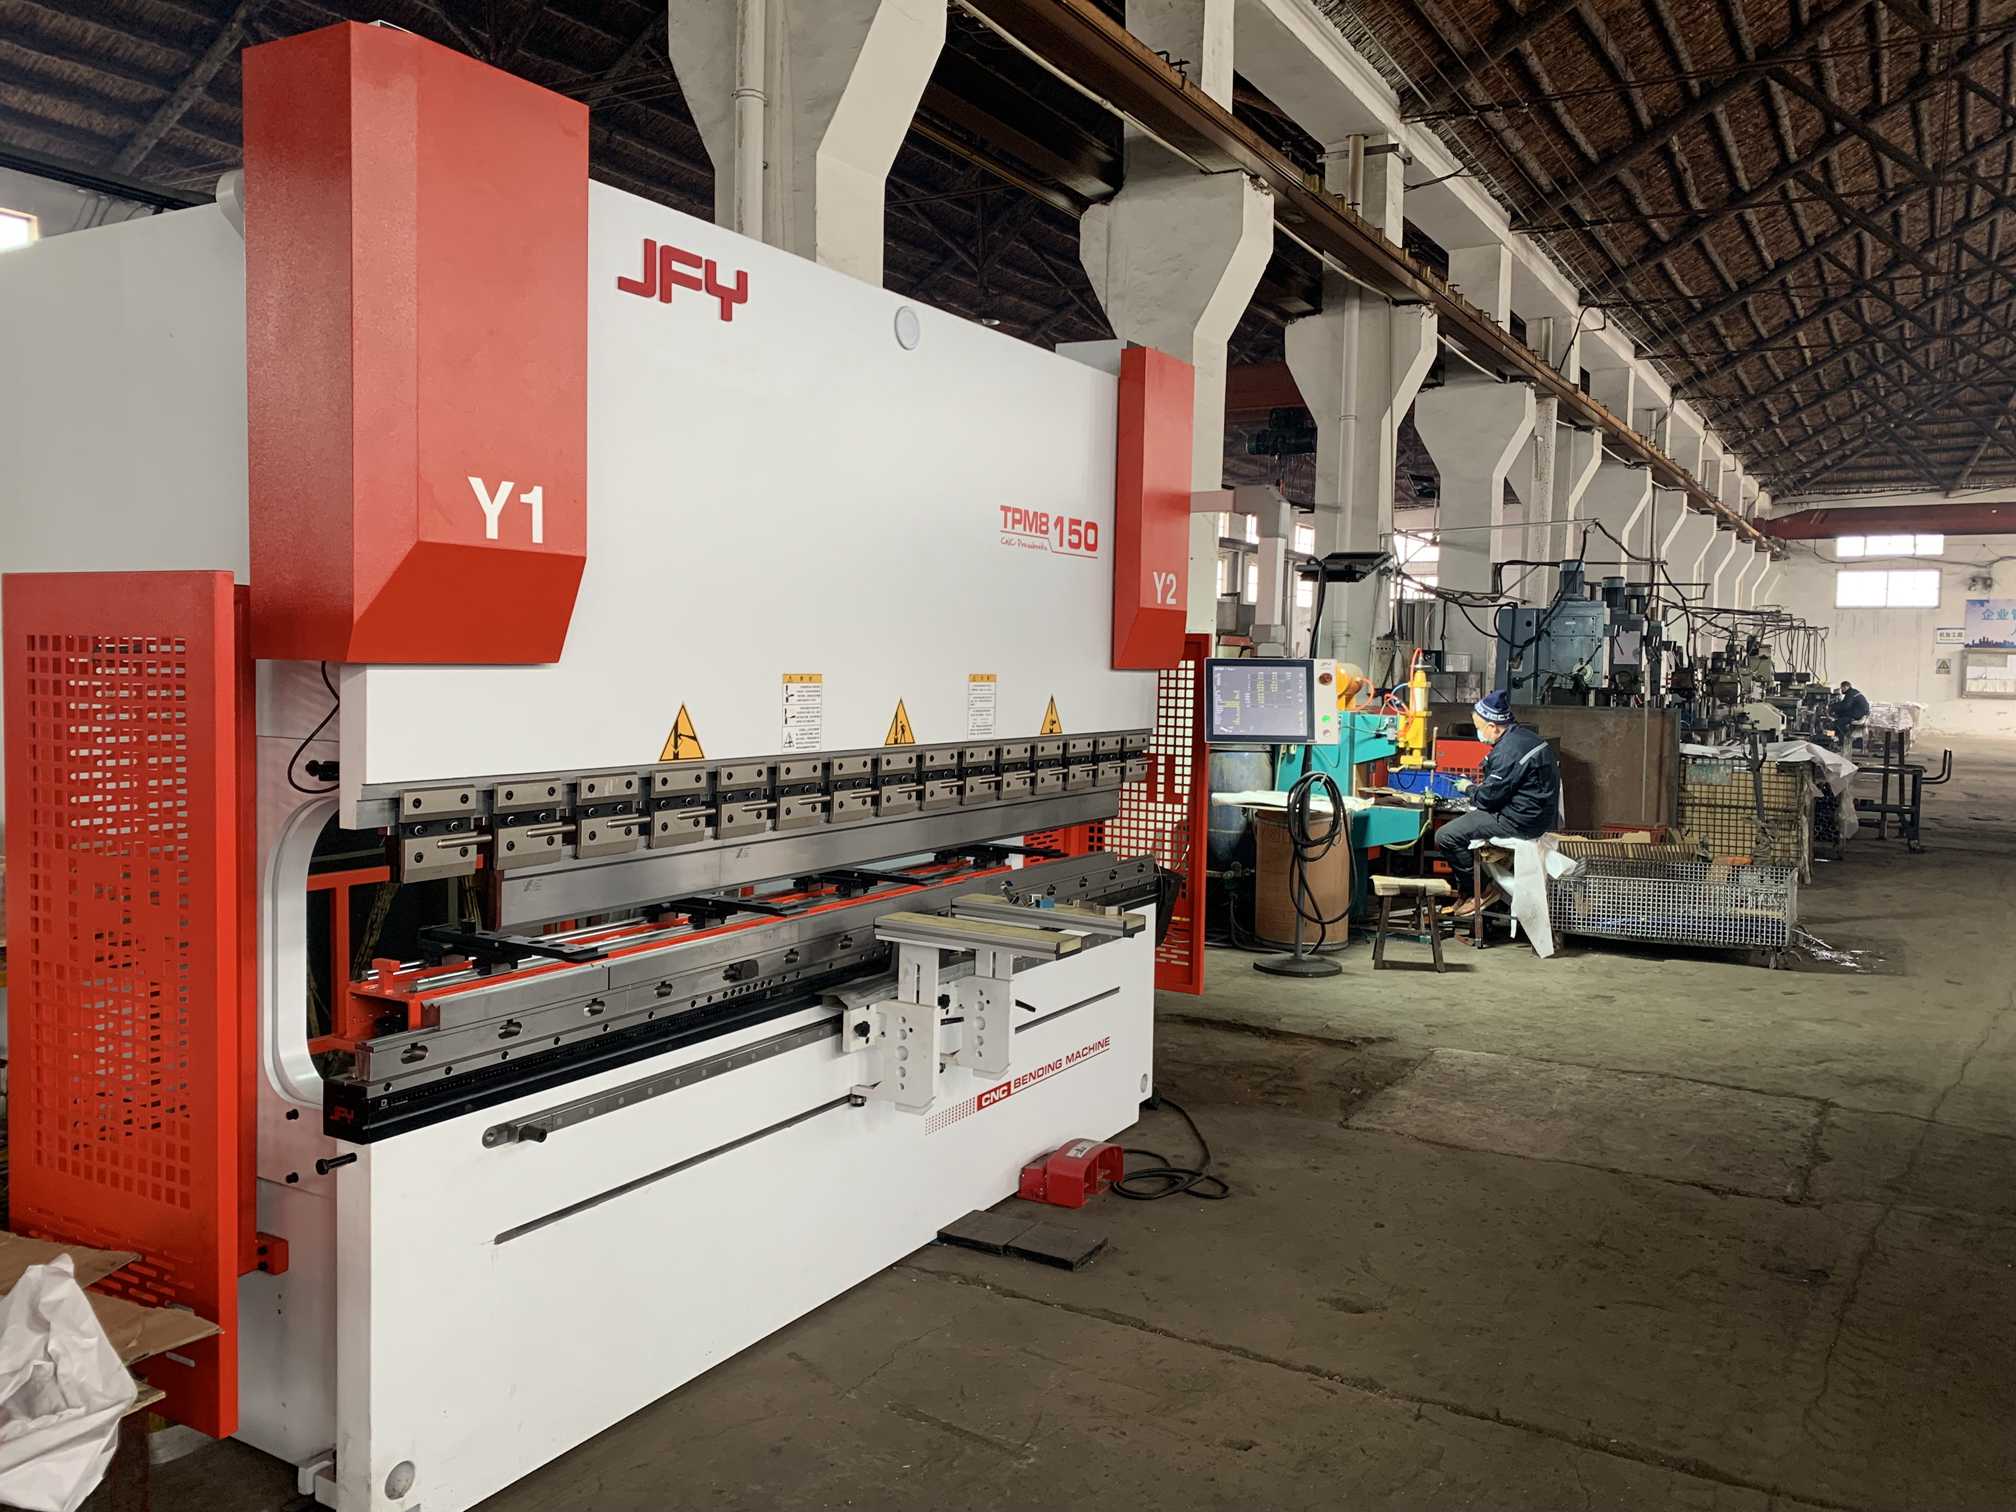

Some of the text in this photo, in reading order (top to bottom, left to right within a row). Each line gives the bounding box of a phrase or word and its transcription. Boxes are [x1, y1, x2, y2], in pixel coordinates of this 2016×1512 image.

[617, 238, 749, 322] JFY
[467, 476, 544, 544] Y1
[1054, 515, 1099, 552] 150
[1152, 571, 1177, 605] Y2
[981, 1036, 1111, 1107] CNC BENDING MACHINE
